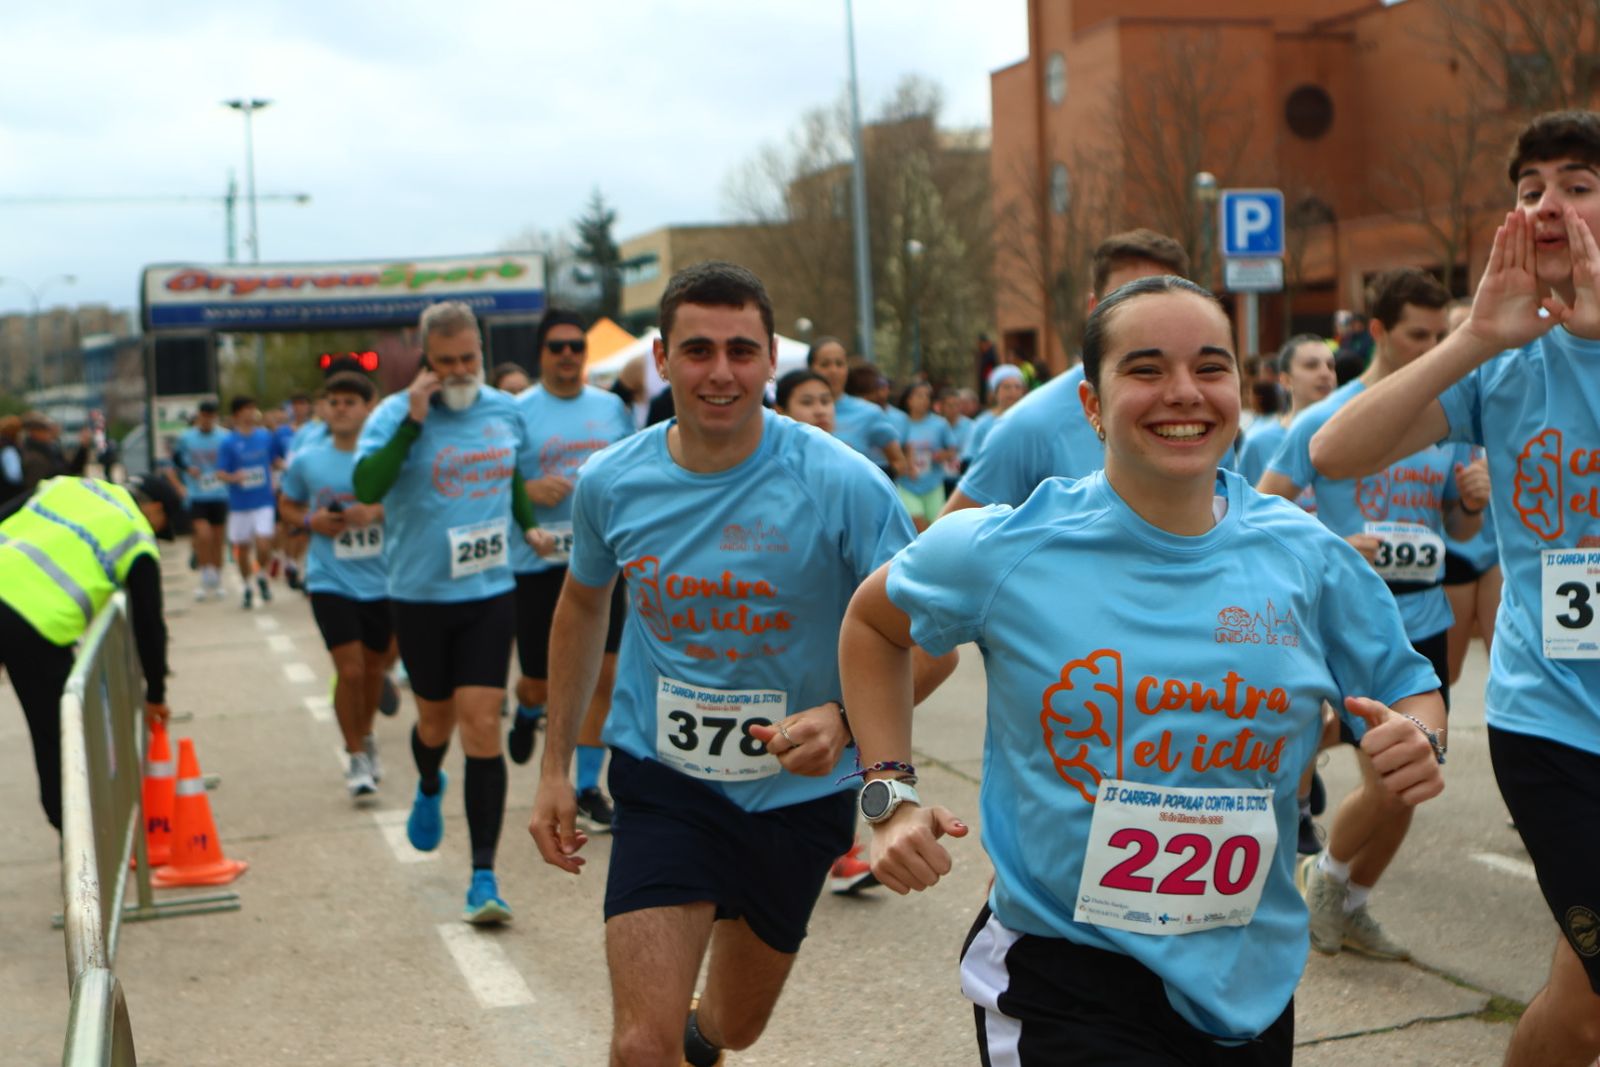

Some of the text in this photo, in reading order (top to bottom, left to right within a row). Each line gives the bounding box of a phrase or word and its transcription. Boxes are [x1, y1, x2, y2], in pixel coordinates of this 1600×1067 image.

[1235, 199, 1272, 248] P
[456, 534, 504, 564] 285
[1375, 541, 1439, 568] 393
[672, 604, 797, 636] el ictus
[1555, 581, 1600, 630] 3
[1215, 633, 1261, 644] UNIDAD
[1267, 634, 1278, 645] DE
[671, 686, 696, 700] CARRERA
[697, 692, 726, 704] POPULAR
[726, 694, 752, 705] CONTRA
[753, 694, 762, 704] EL
[762, 693, 783, 704] ICTUS
[668, 710, 773, 757] 378
[1133, 727, 1286, 773] el ictus
[1119, 788, 1162, 807] CARRERA
[1162, 794, 1204, 811] POPULAR
[1205, 795, 1236, 812] CONTRA
[1236, 796, 1245, 811] EL
[1246, 796, 1268, 811] ICTUS
[1098, 827, 1261, 896] 220
